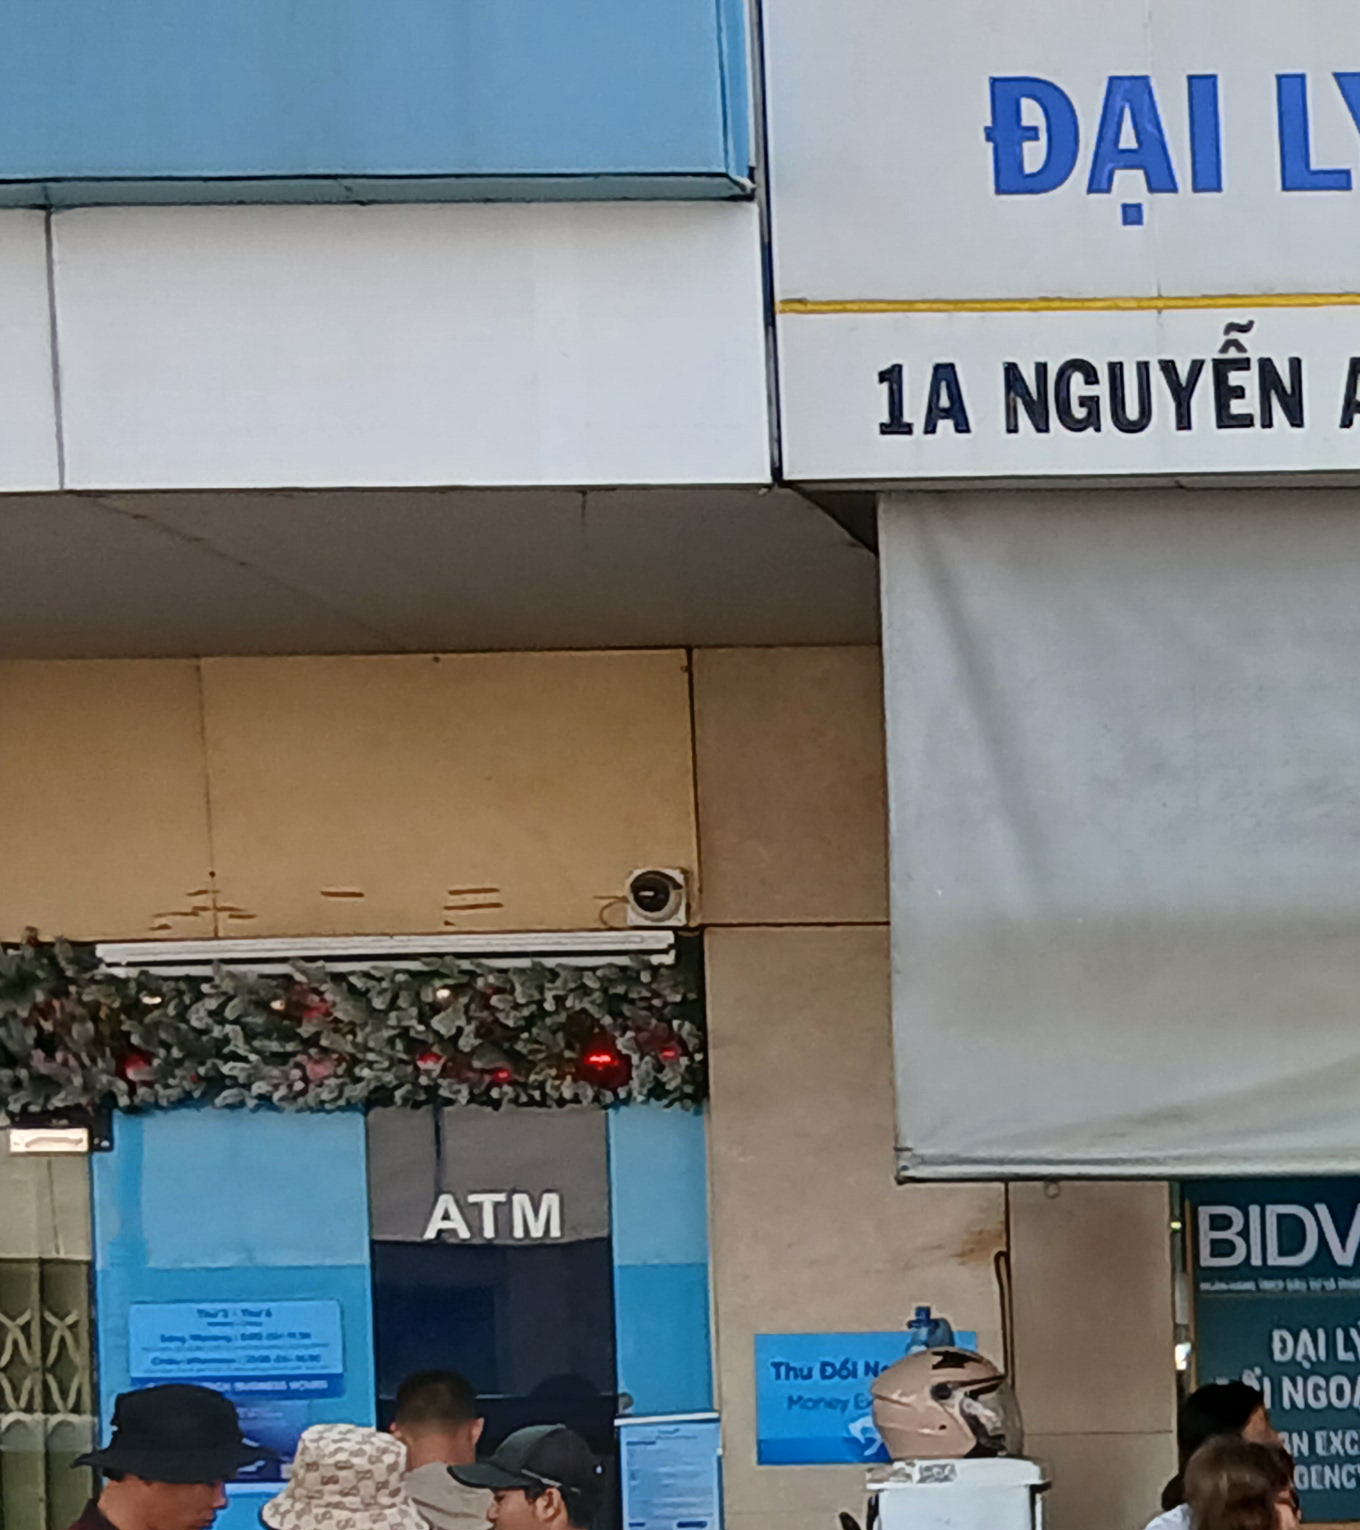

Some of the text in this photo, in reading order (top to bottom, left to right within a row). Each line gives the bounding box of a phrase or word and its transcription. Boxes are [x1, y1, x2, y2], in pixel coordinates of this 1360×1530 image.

[985, 74, 1222, 225] ĐẠI
[878, 362, 971, 435] 1A
[1005, 320, 1305, 432] NGUYỄN
[423, 1193, 561, 1241] ATM
[1272, 1327, 1326, 1369] ĐẠI
[771, 1361, 813, 1381] Thu
[787, 1394, 848, 1413] Money
